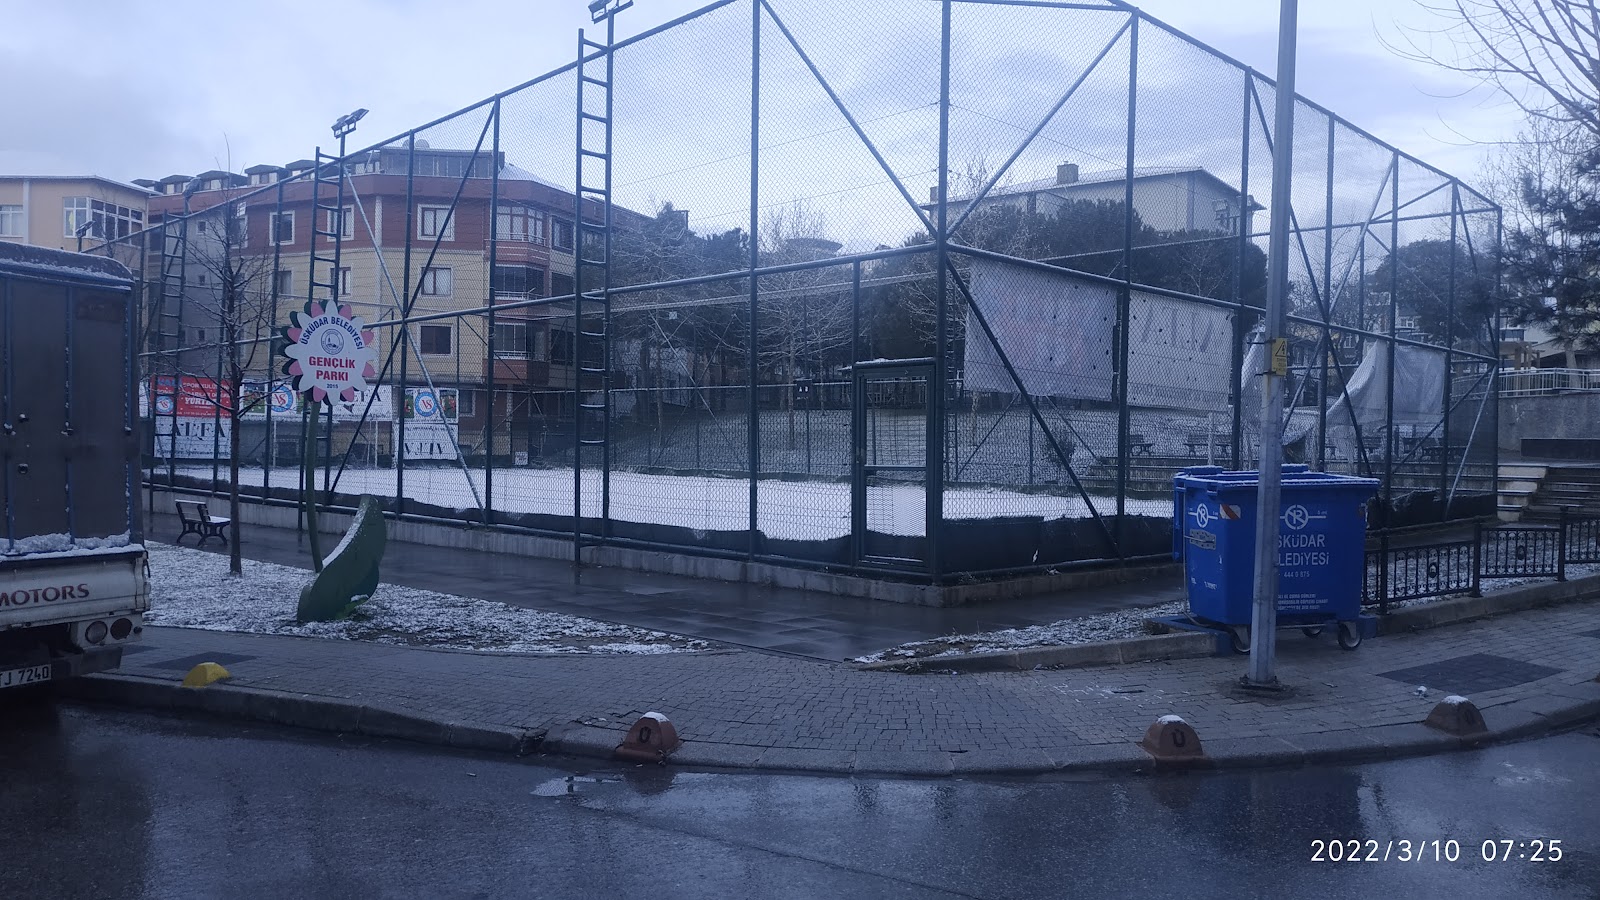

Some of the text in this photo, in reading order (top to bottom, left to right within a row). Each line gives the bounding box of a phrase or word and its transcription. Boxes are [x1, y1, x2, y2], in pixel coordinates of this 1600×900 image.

[301, 317, 328, 345] ÜSKÜDAR
[331, 316, 364, 350] BELEDİYESİ
[309, 356, 355, 369] GENÇLİK
[316, 370, 349, 381] PARKI
[1278, 534, 1325, 548] SKÜDAR
[18, 665, 49, 682] 7240
